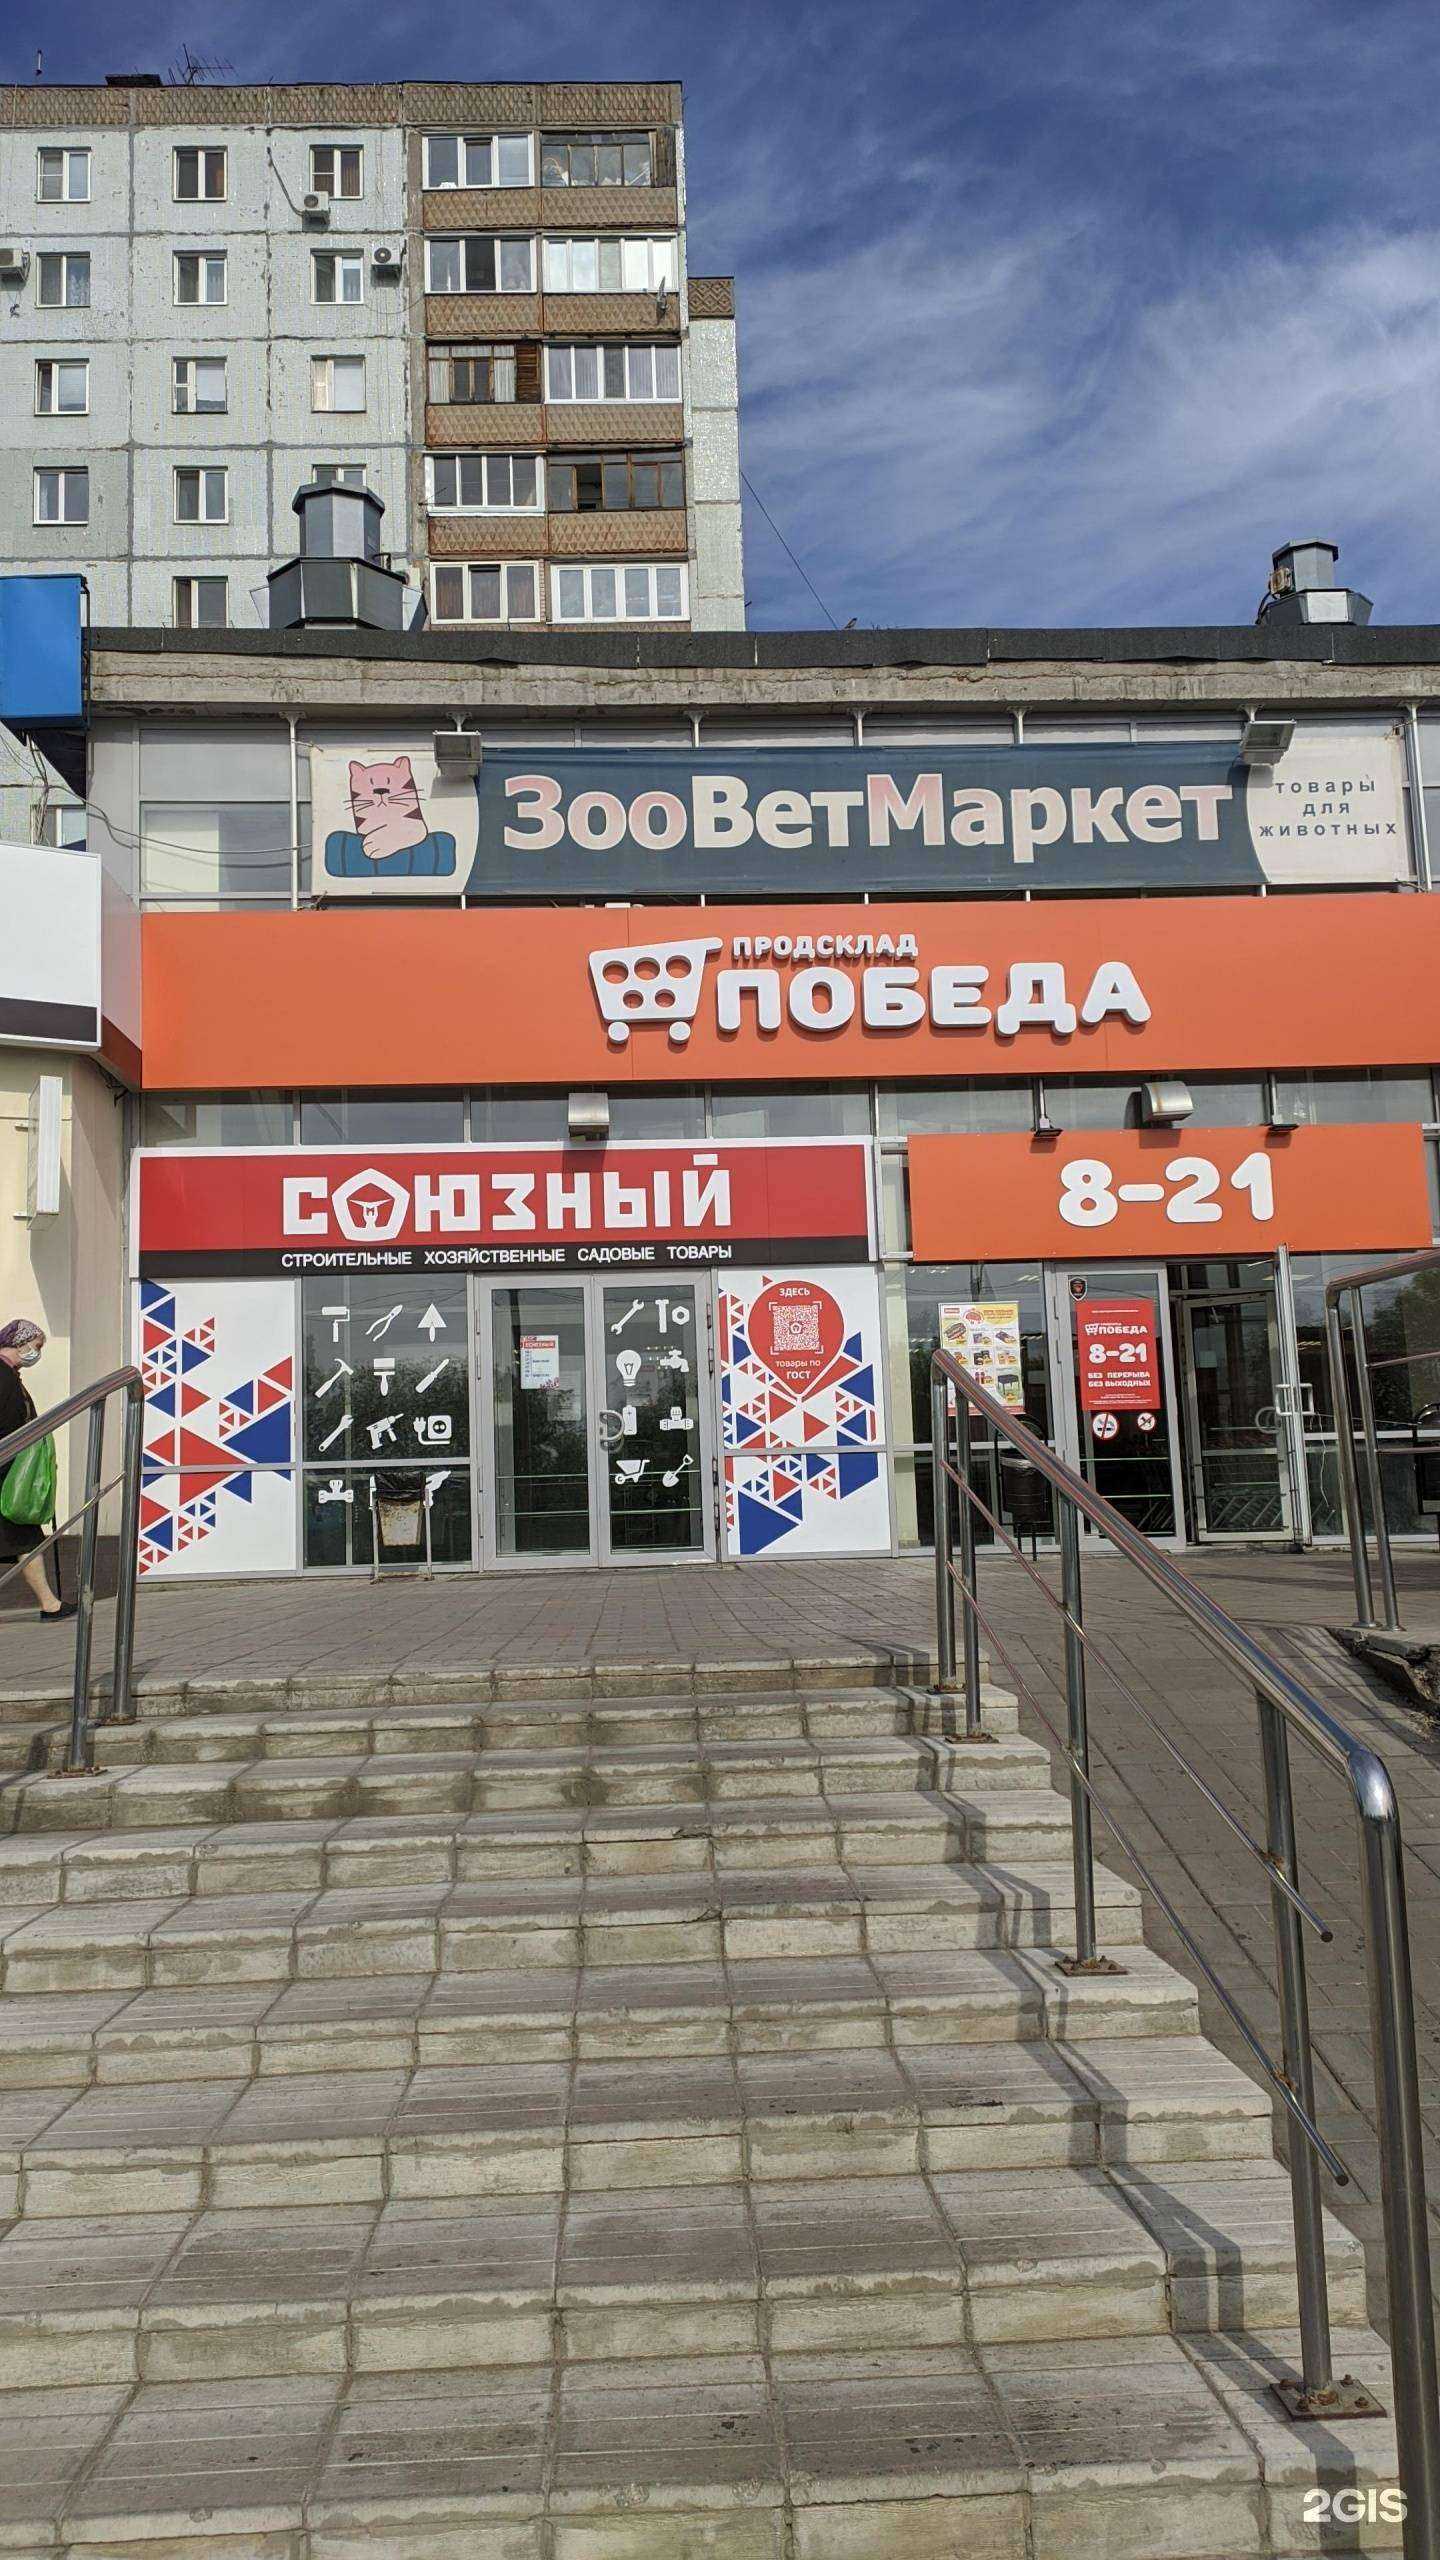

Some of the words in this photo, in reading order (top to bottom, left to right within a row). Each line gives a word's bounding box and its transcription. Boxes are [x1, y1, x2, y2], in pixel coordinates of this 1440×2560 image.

[1275, 780, 1375, 795] товары
[503, 773, 1233, 864] ЗооВетМаркет
[1303, 803, 1350, 816] для
[1259, 823, 1397, 837] животных
[732, 933, 919, 959] ПРОДСКЛАД
[716, 961, 1152, 1037] ПОБЕДА
[282, 1153, 732, 1242] СОЮЗНЫЙ
[1058, 1152, 1275, 1227] 8-21
[281, 1251, 412, 1268] СТРОИТЕЛЬНЫЕ
[424, 1248, 566, 1265] ХОЗЯЙСТВЕННЫЕ
[577, 1247, 656, 1263] САДОВЫЕ
[667, 1245, 732, 1260] ТОВАРЫ
[779, 1287, 810, 1297] ЗДЕСЬ
[1099, 1325, 1148, 1334] ПОБЕДА
[786, 1371, 811, 1379] ГОСТ
